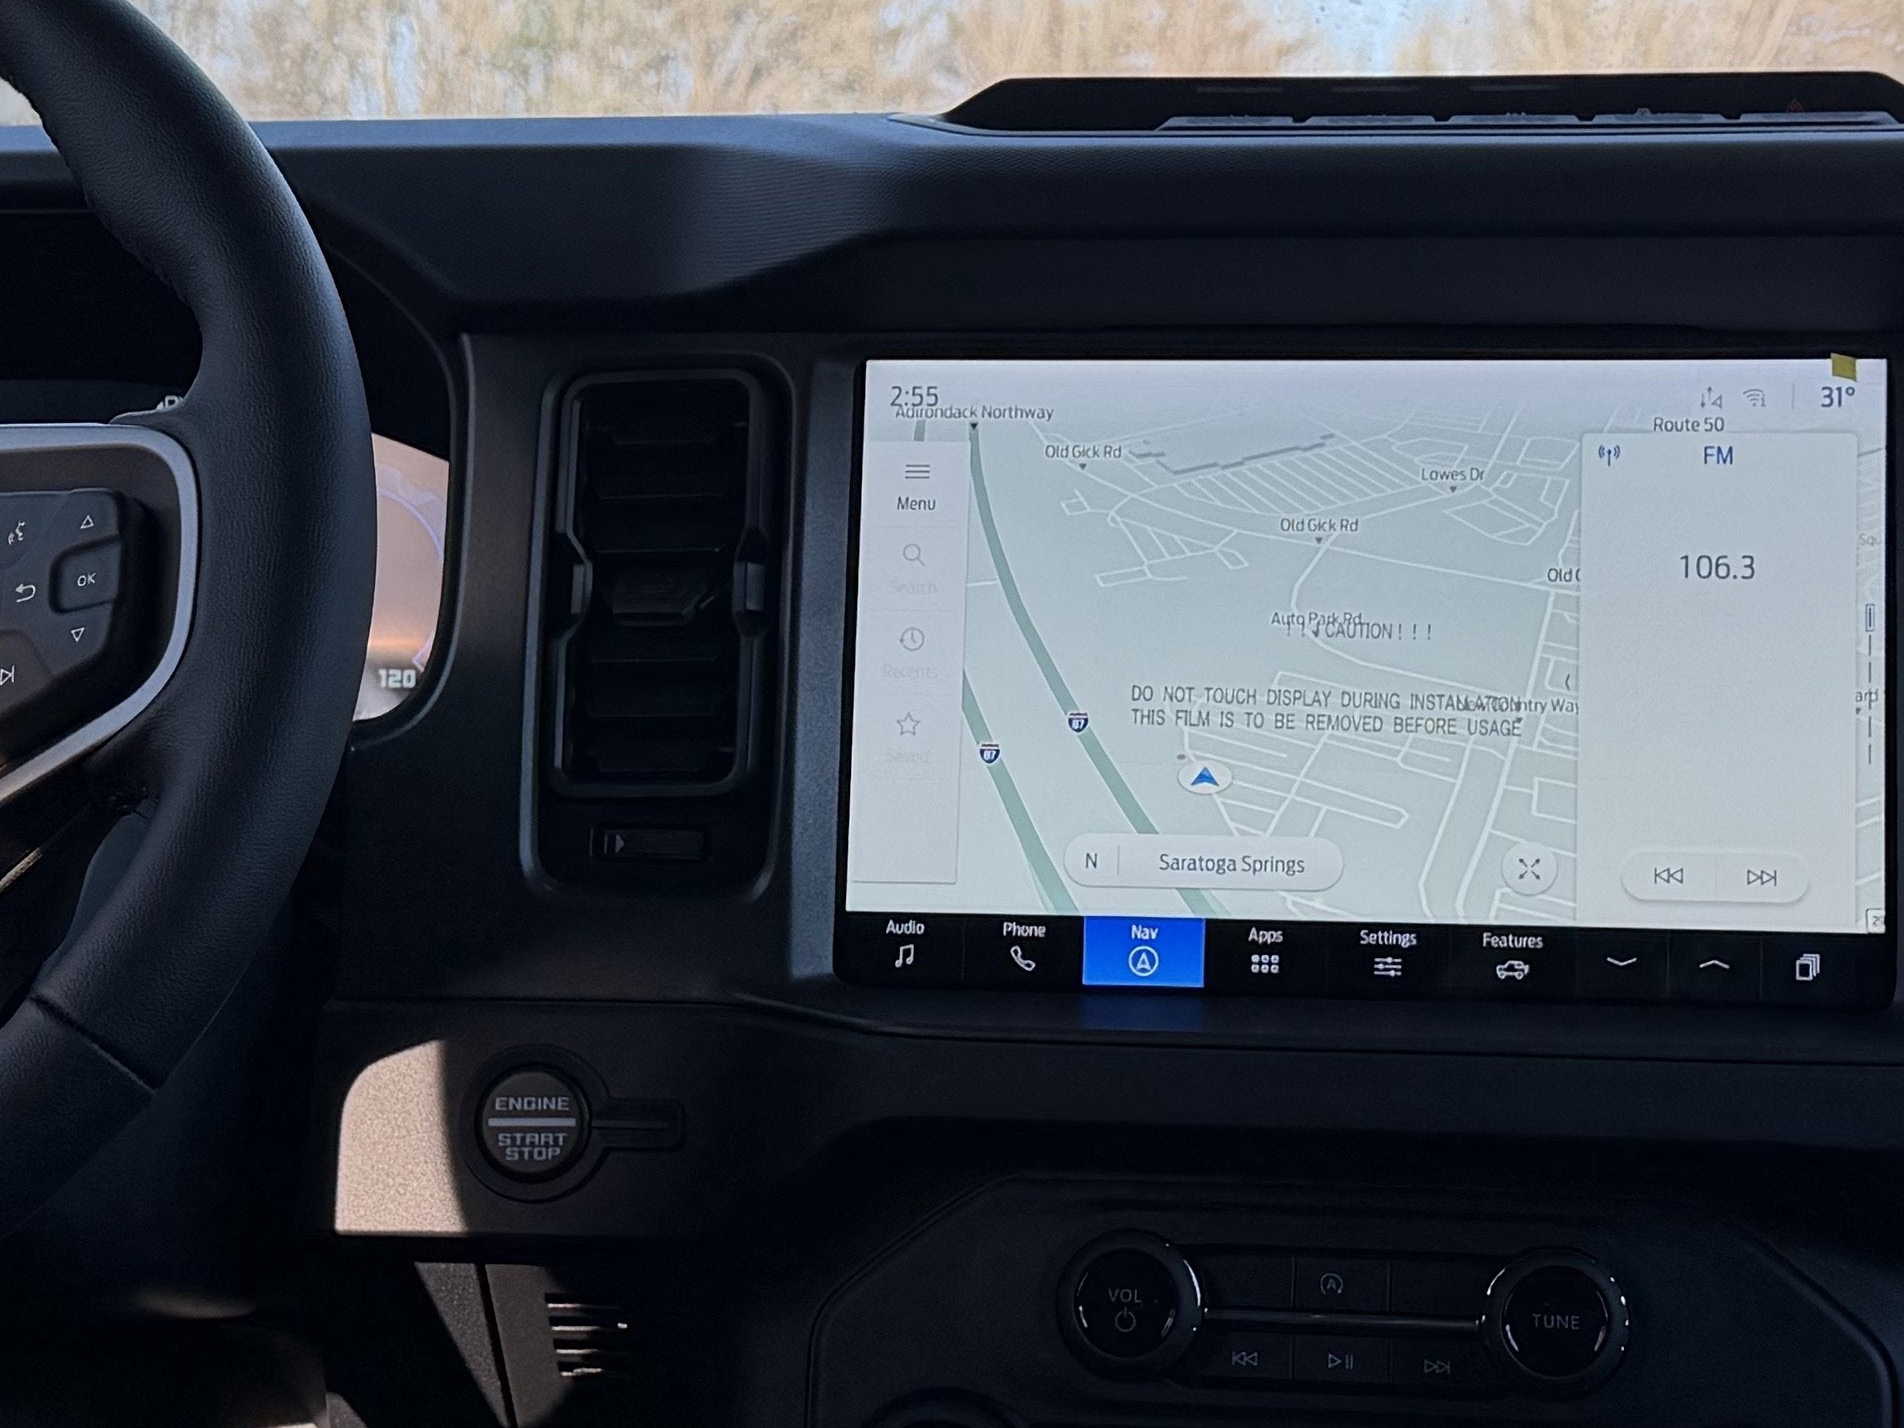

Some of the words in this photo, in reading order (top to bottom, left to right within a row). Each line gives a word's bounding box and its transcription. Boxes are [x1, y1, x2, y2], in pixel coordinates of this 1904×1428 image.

[890, 385, 939, 408] 2:55
[895, 404, 978, 421] Adirondack
[981, 405, 1055, 423] Northway
[1653, 416, 1700, 433] Route
[1703, 416, 1725, 433] 50
[1044, 444, 1070, 460] Old
[1103, 444, 1123, 460] Rd
[1703, 445, 1734, 466] FM
[1421, 466, 1462, 482] Lowes
[1465, 466, 1486, 482] Dr
[896, 496, 937, 512] Menu
[1280, 517, 1305, 533] Old
[1340, 518, 1360, 533] Rd
[1546, 567, 1573, 583] Old
[1679, 554, 1756, 581] 106.3
[76, 571, 97, 587] OK
[1271, 611, 1306, 626] Auto
[378, 668, 417, 689] 120
[1131, 684, 1154, 703] DO
[1163, 685, 1195, 703] NOT
[1204, 686, 1257, 706] TOUCH
[1266, 688, 1332, 707] DISPLAY
[1341, 690, 1401, 710] DURING
[1131, 708, 1166, 727] THIS
[1174, 709, 1210, 728] FILM
[1219, 711, 1234, 729] IS
[1245, 711, 1265, 730] TO
[1274, 712, 1296, 731] BE
[1305, 713, 1384, 733] REMOVED
[1393, 716, 1457, 735] BEFORE
[1466, 718, 1522, 737] USAGE
[1084, 852, 1098, 869] N
[1159, 853, 1237, 875] Saratoga
[1240, 854, 1306, 877] Springs
[885, 919, 926, 936] Audio
[1002, 921, 1047, 938] Phone
[1130, 924, 1159, 940] Nav
[1247, 928, 1284, 945] Apps
[1359, 928, 1418, 949] Settings
[1482, 931, 1544, 950] Features
[495, 1096, 571, 1112] ENGINE
[497, 1131, 569, 1147] START
[504, 1146, 562, 1162] STOP
[1107, 1286, 1144, 1304] VOL
[1531, 1311, 1582, 1332] TUNE
